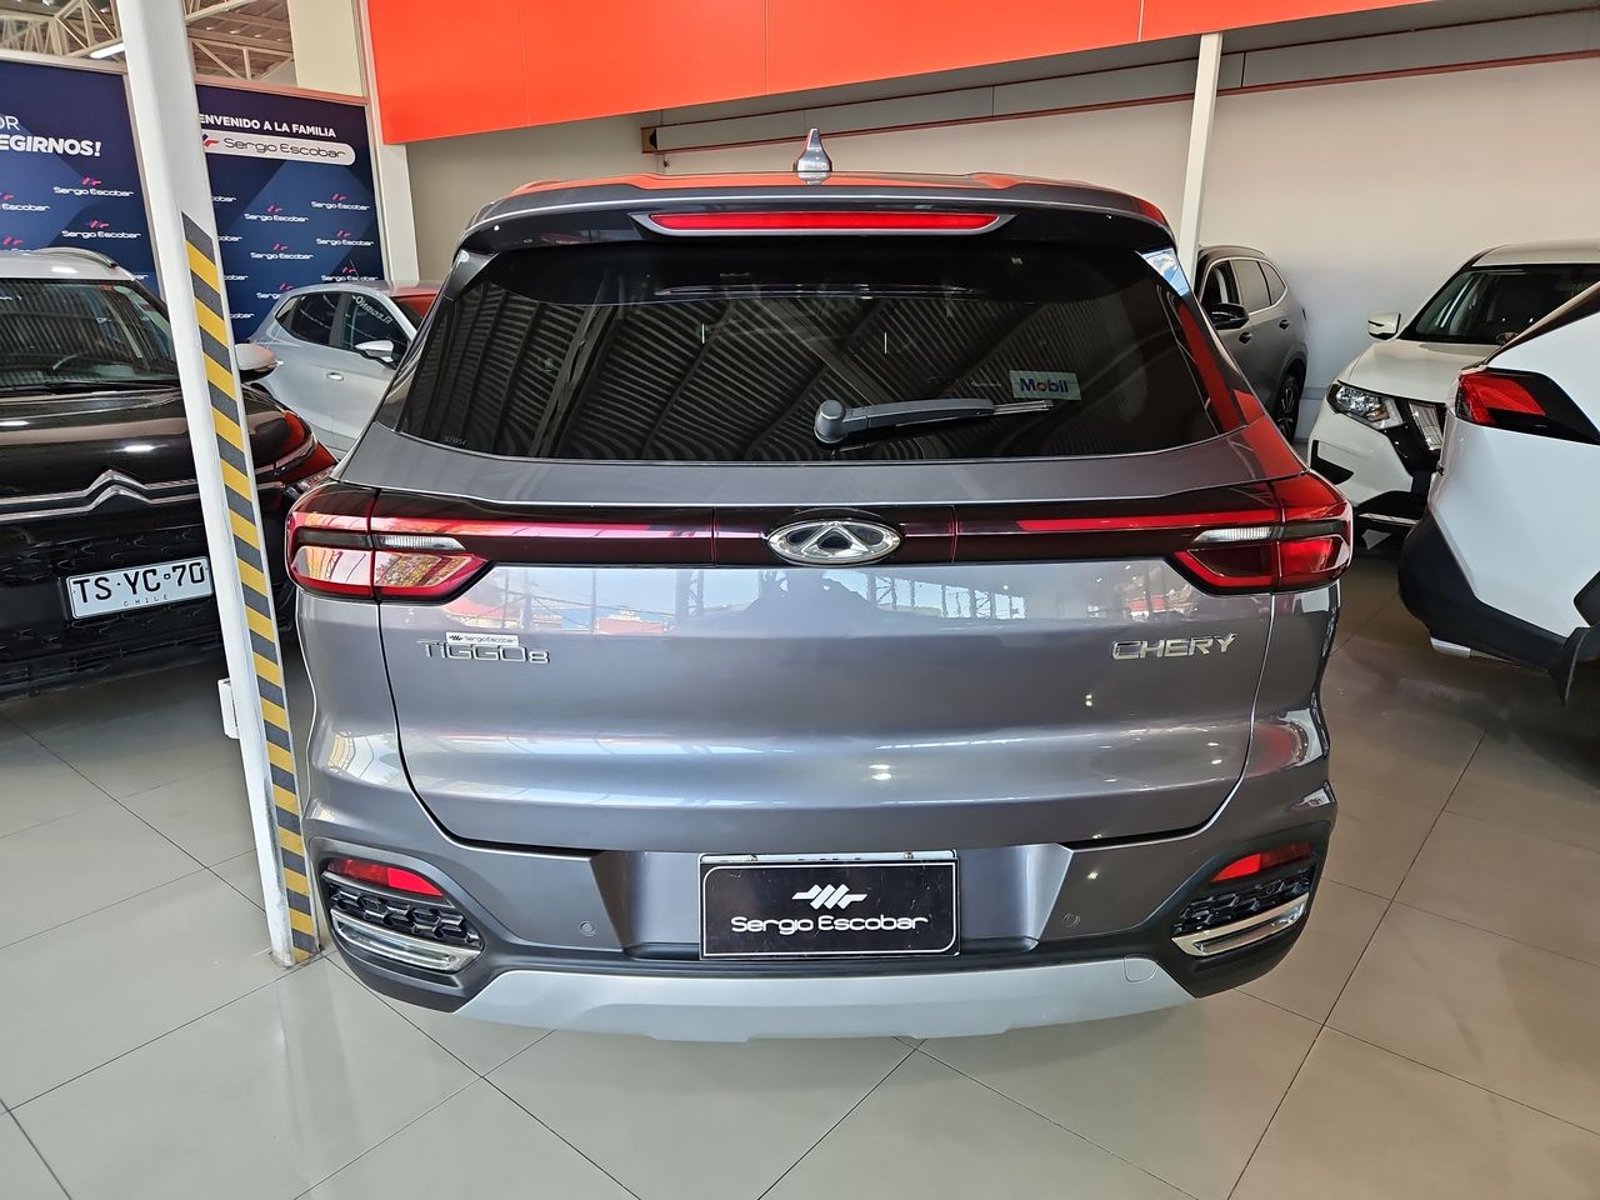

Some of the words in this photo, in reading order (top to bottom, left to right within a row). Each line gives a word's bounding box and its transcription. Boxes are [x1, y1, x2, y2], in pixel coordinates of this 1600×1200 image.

[263, 120, 272, 131] A
[274, 121, 290, 133] LA
[292, 125, 337, 138] FAMILIA
[223, 138, 277, 154] Sergio
[280, 143, 346, 159] Escobar
[1020, 378, 1069, 393] Mobil
[123, 594, 168, 607] CHILE
[1111, 633, 1237, 660] CHERY
[730, 915, 814, 936] Sergio
[817, 914, 929, 932] Escobar
